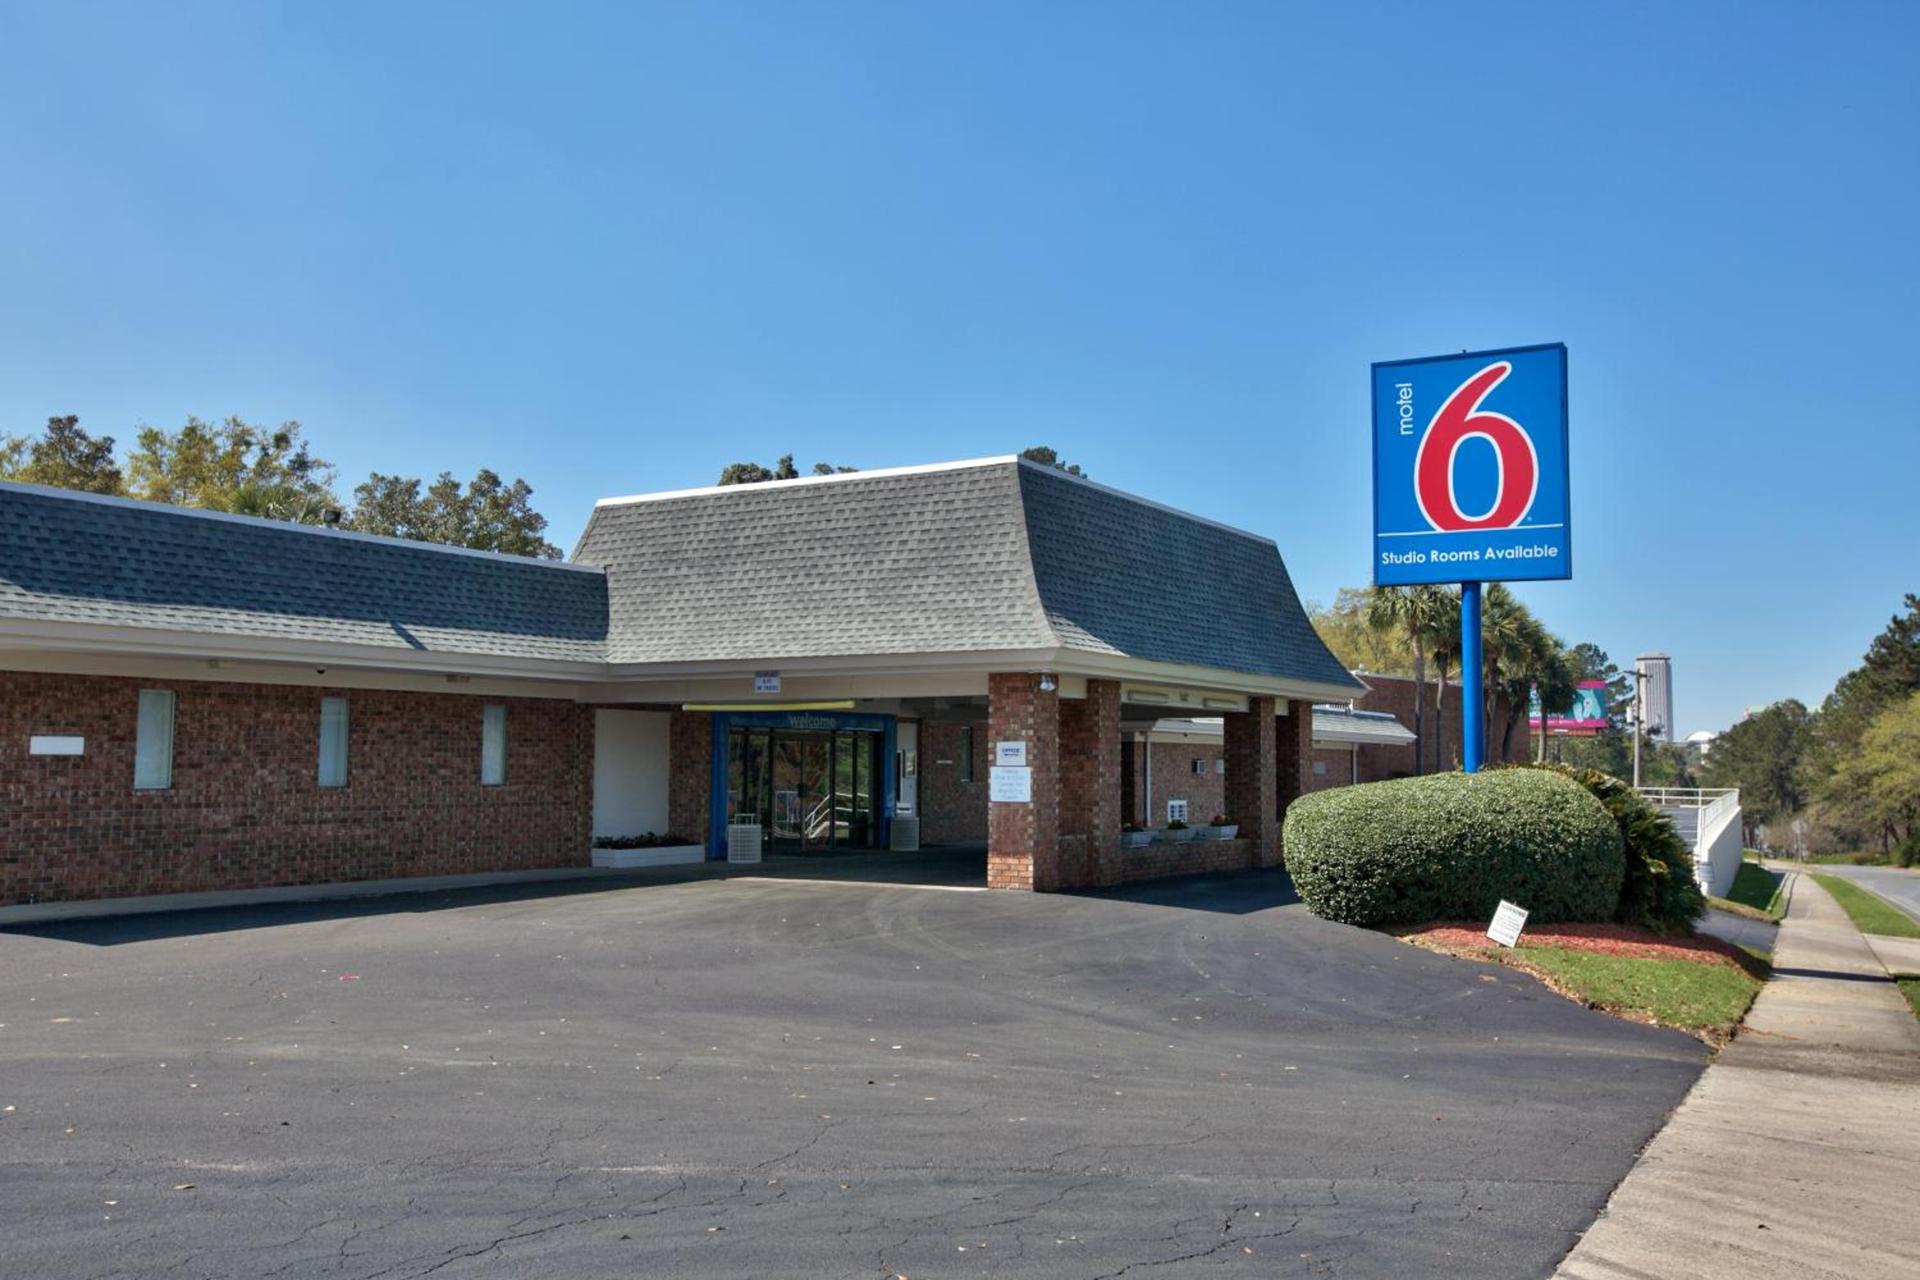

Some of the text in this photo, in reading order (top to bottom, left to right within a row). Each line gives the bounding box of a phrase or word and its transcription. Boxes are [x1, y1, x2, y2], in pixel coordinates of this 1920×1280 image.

[1395, 360, 1540, 533] motel 6
[1381, 544, 1559, 565] Studio Rooms Available
